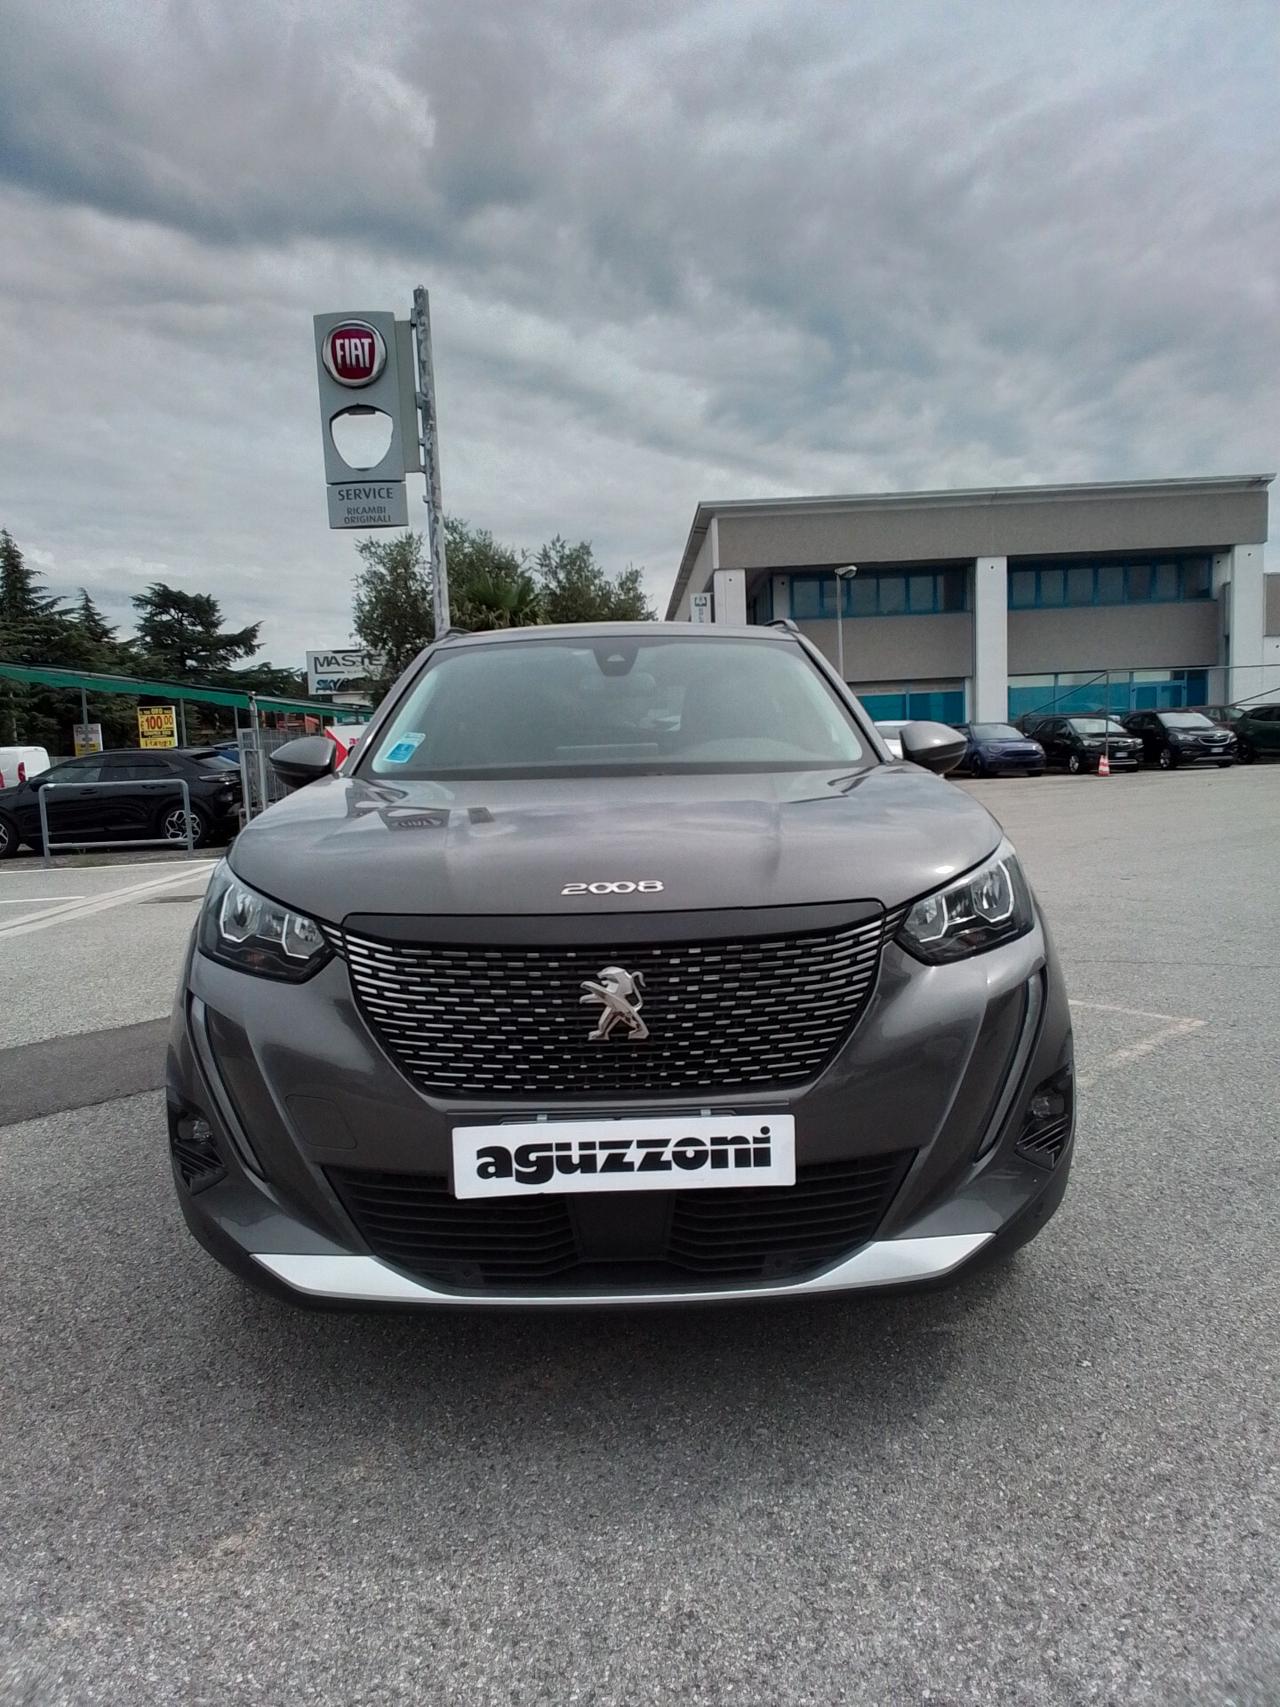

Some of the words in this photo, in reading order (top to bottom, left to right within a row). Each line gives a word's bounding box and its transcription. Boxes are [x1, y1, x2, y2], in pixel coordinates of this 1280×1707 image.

[335, 338, 372, 368] FIAT
[338, 487, 394, 501] SERVICE
[346, 506, 386, 515] RICAMBI
[344, 515, 392, 525] ORIGINALI
[314, 654, 384, 673] MASTE
[561, 880, 665, 896] 2008
[476, 1126, 771, 1185] aguzzoni
